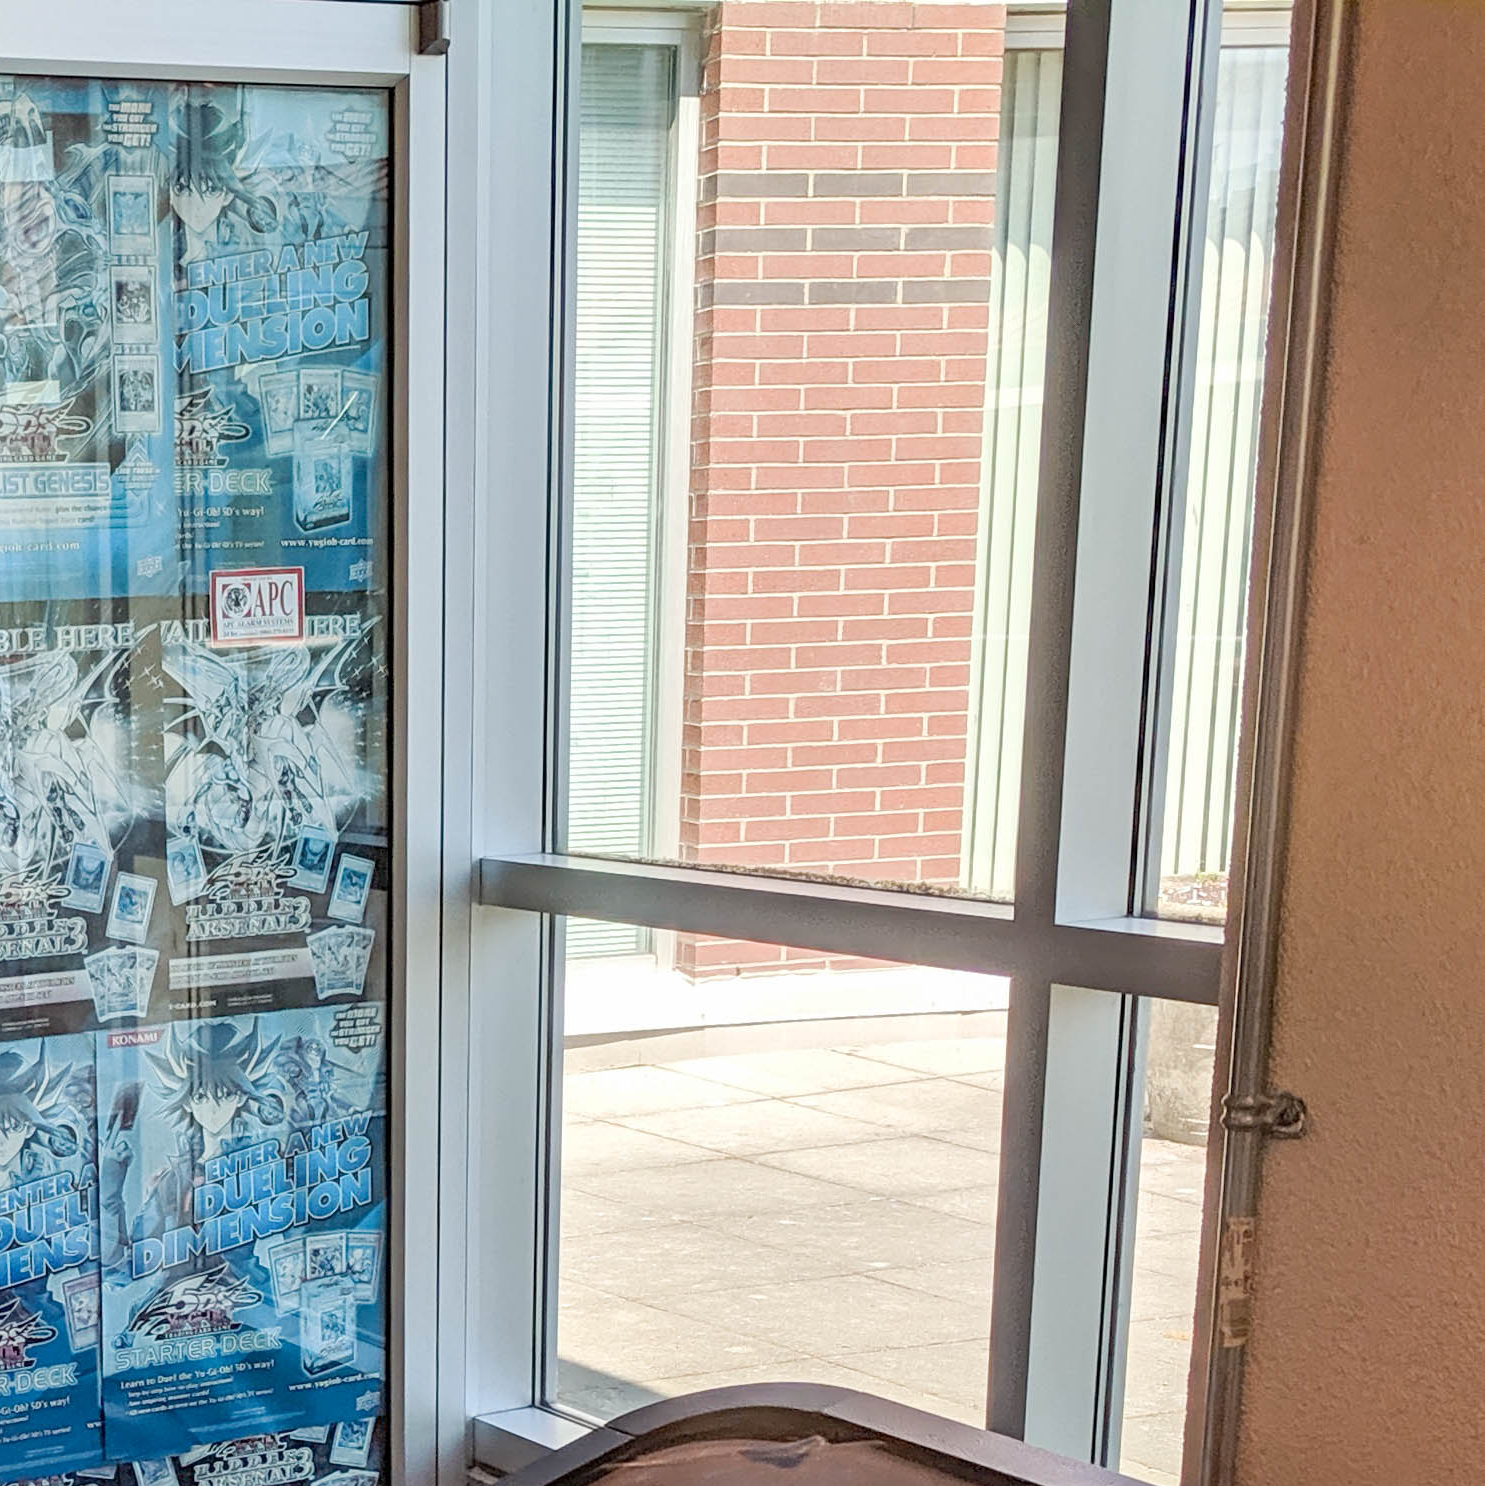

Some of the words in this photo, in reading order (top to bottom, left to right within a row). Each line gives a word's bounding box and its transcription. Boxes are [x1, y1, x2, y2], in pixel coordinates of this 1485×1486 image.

[188, 251, 274, 289] ENTER
[277, 245, 300, 273] A
[305, 232, 369, 268] NEW
[174, 260, 369, 335] DUELING
[173, 299, 369, 374] MENSION
[33, 470, 110, 495] GENESIS
[209, 468, 273, 496] DECK
[252, 580, 294, 617] APC
[56, 621, 136, 650] HERE
[186, 914, 292, 941] ARSENAL
[113, 1032, 159, 1047] KONAMI
[205, 1140, 279, 1184] ENTER
[285, 1132, 308, 1158] A
[312, 1111, 372, 1149] NEW
[78, 1163, 97, 1190] A
[194, 1136, 371, 1224] DUELING
[133, 1168, 371, 1280] DIMENSION
[114, 1336, 217, 1371] STARTER
[222, 1325, 282, 1356] DECK
[16, 1361, 79, 1395] DECK
[121, 1378, 145, 1390] Learn
[158, 1373, 178, 1384] Duel
[179, 1371, 193, 1381] the
[254, 1359, 275, 1371] way!
[49, 1396, 70, 1408] way!
